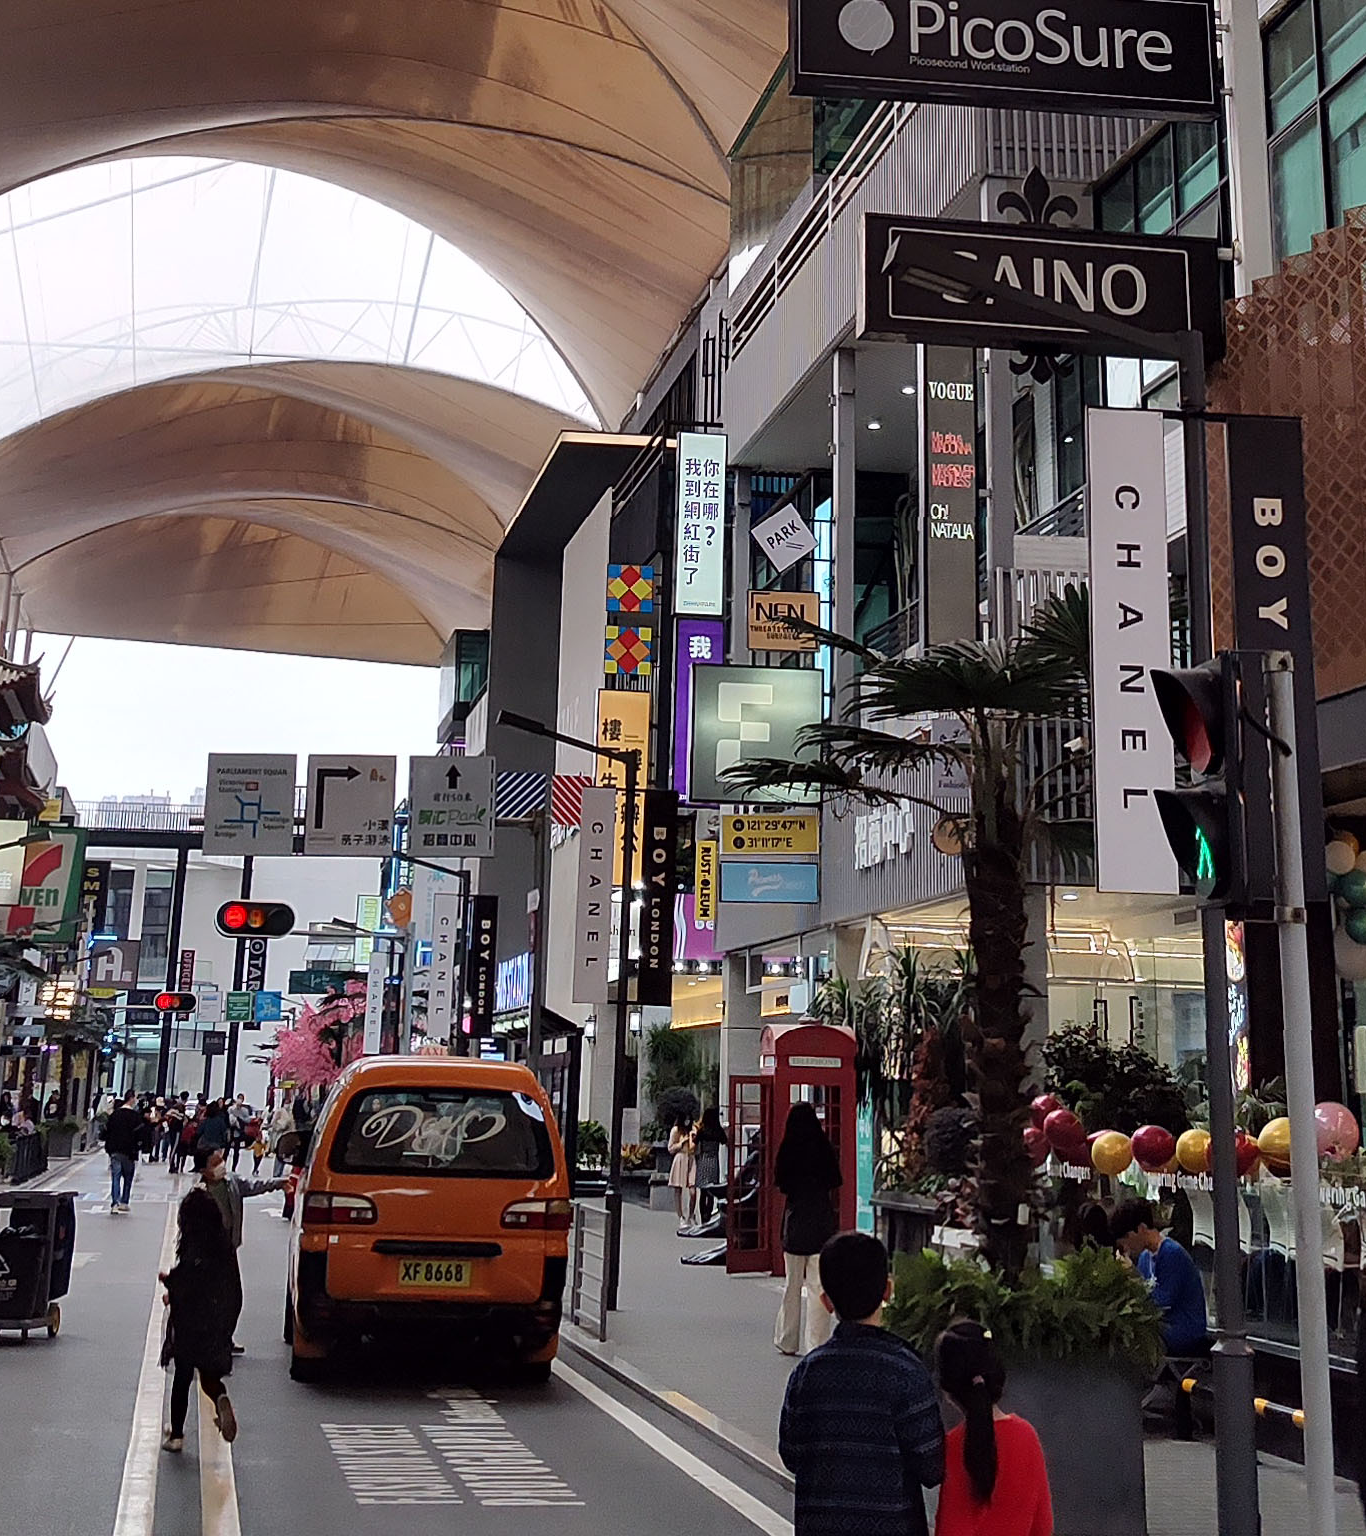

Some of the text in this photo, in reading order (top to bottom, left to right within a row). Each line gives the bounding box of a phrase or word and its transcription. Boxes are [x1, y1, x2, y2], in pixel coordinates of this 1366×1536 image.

[909, 54, 1031, 75] Picosecond Workstation
[928, 381, 975, 402] VOGUE
[682, 457, 702, 586] 我到網紅街了
[701, 458, 721, 547] 你在哪?
[766, 520, 801, 550] PARK
[930, 503, 949, 520] Oh!
[930, 522, 975, 540] NATALIA
[1252, 497, 1290, 630] BOY
[1113, 484, 1150, 810] CHANEL
[584, 821, 605, 968] CHANEL
[648, 825, 668, 970] BOY LONDON
[368, 968, 380, 1038] CHANEL
[435, 916, 449, 1015] CHANEL
[477, 919, 492, 1015] BOY LONDON
[423, 1263, 464, 1283] 8668
[319, 1422, 465, 1505] FASHION STREET
[418, 1424, 586, 1506] PHOTOGRAPHY
